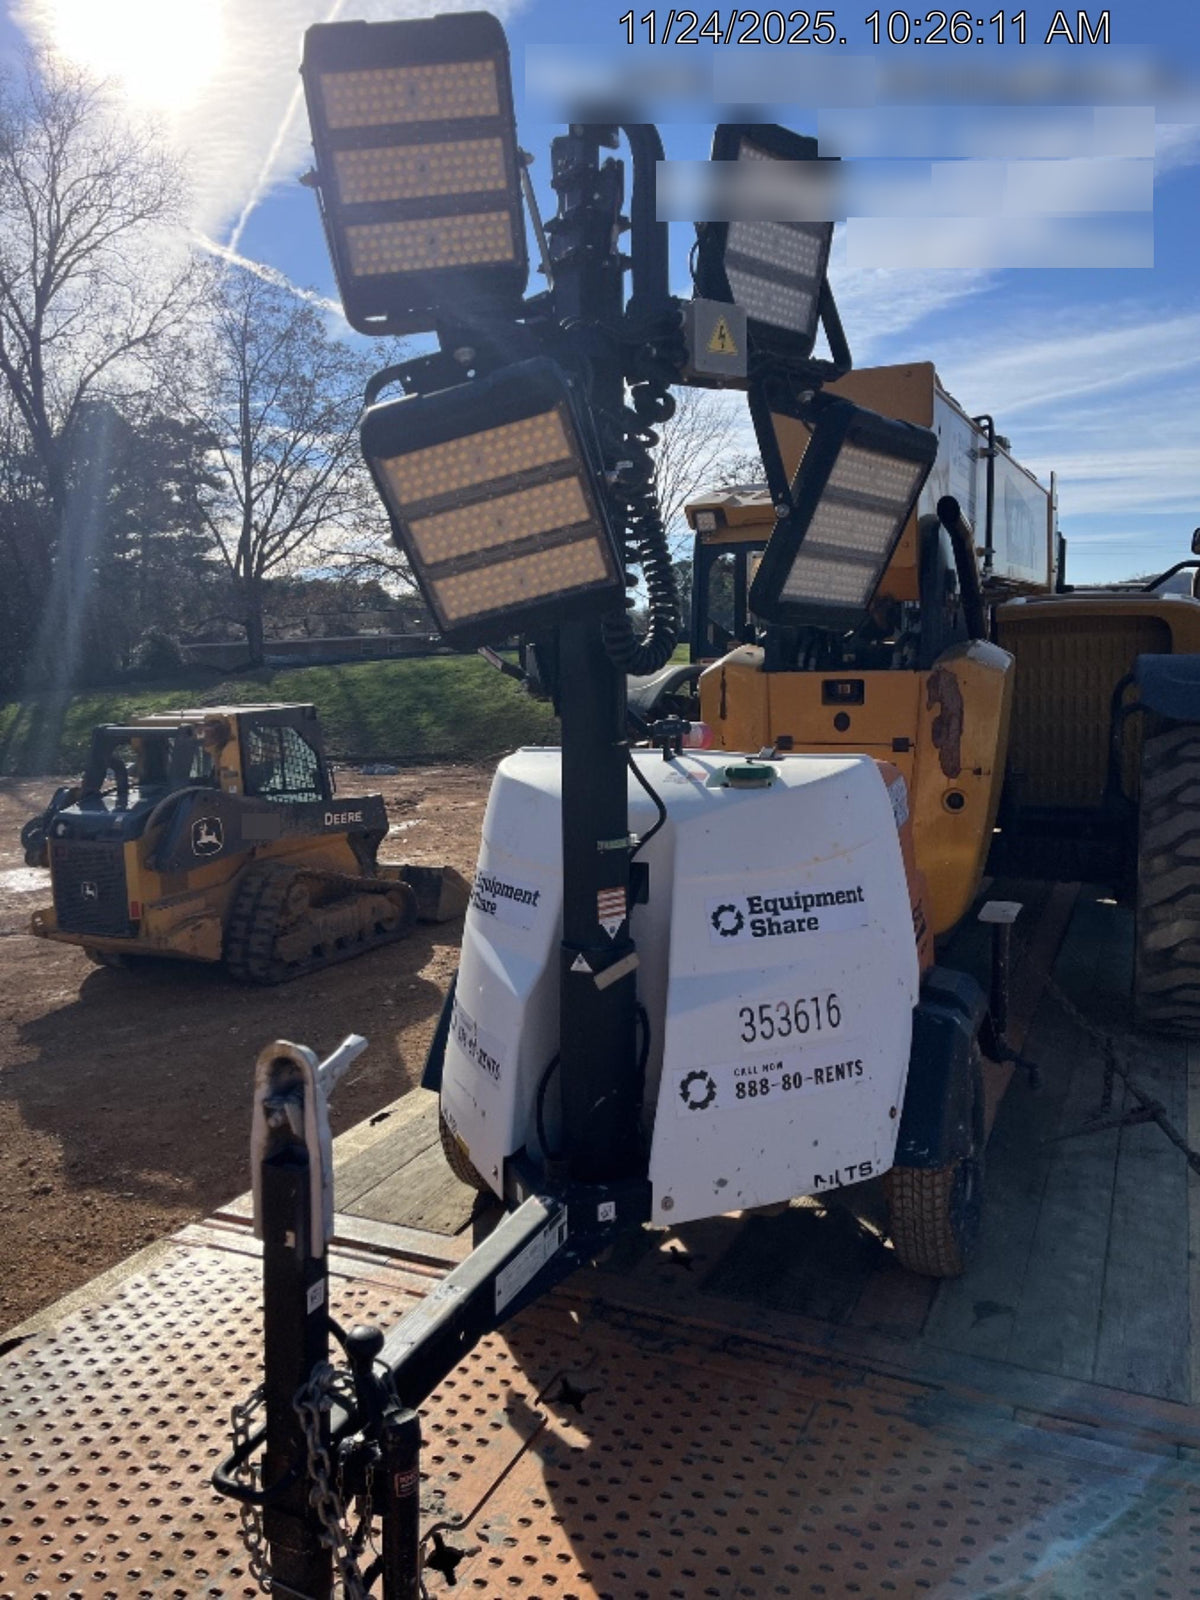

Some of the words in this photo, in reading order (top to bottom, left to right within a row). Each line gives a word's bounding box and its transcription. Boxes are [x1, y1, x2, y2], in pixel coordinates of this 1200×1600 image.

[324, 811, 363, 826] DEERE
[746, 885, 865, 916] Equipment
[750, 916, 820, 938] Share
[739, 993, 842, 1043] 353616
[734, 1066, 758, 1077] CALL
[735, 1059, 864, 1100] 888-80-RENTS
